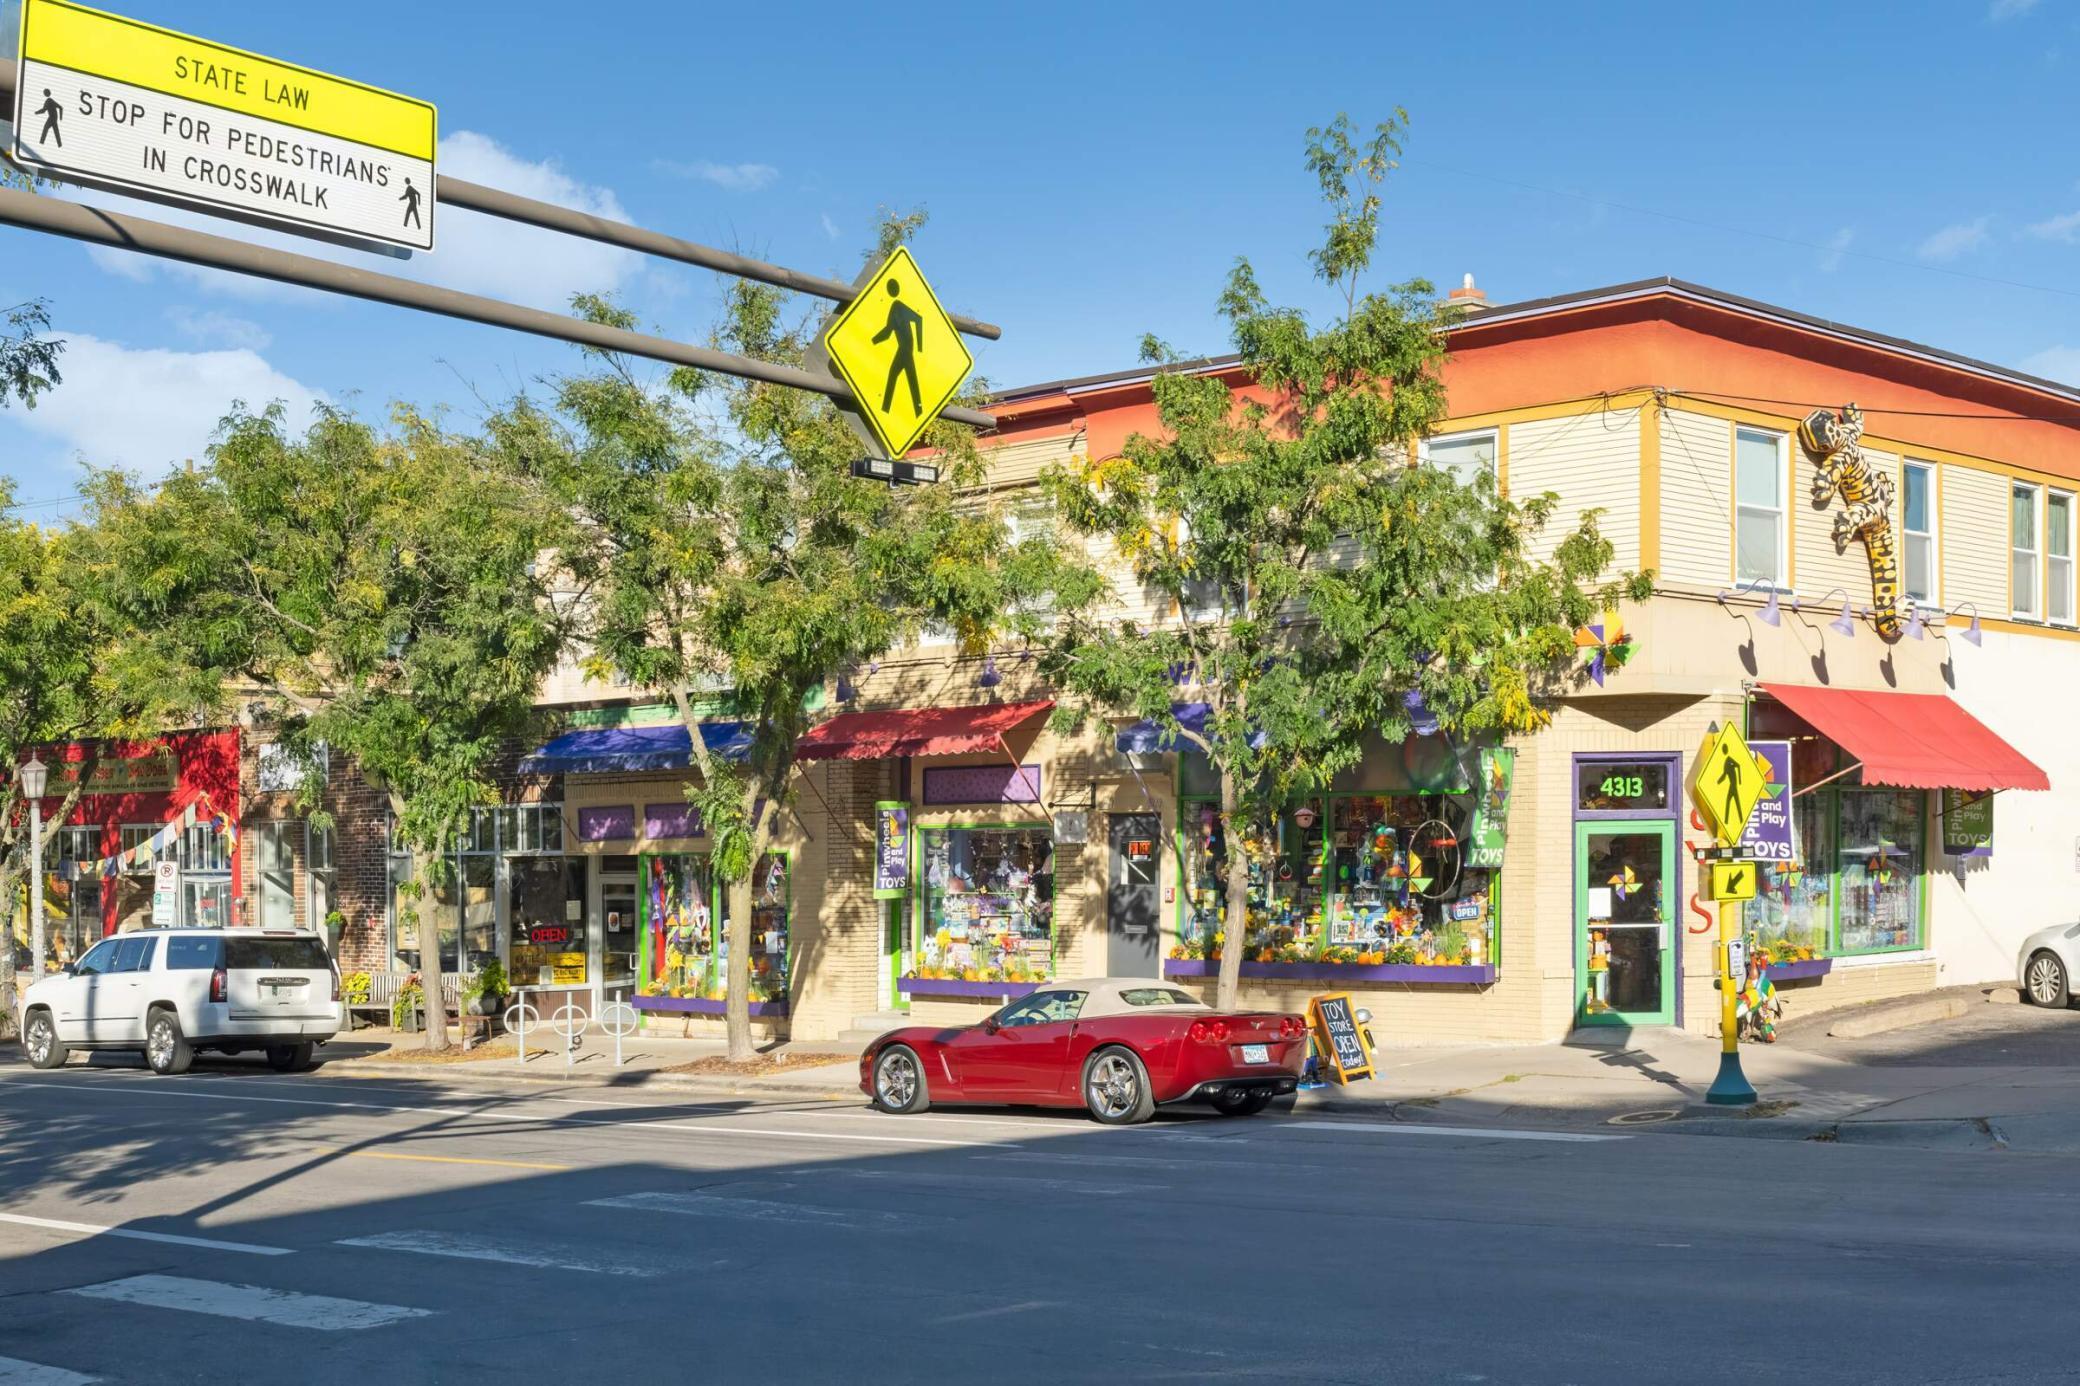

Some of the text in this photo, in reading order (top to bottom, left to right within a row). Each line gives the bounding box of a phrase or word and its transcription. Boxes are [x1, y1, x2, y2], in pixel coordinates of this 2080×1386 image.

[174, 55, 310, 111] STATE LAW
[78, 89, 391, 187] STOP FOR PEDESTRIANS
[143, 145, 329, 211] IN CROSSWALK
[1600, 776, 1643, 797] 4313
[1761, 800, 1782, 812] and
[1761, 812, 1787, 829] Play
[1963, 811, 1986, 823] Play
[880, 810, 890, 877] Pinwheels
[1948, 832, 1988, 846] TOYS
[891, 848, 904, 857] and
[1471, 848, 1505, 866] TOYS
[891, 857, 905, 868] Play
[880, 876, 906, 888] TOYS
[1456, 907, 1477, 918] OPEN
[531, 927, 567, 943] OPEN
[1320, 1000, 1346, 1020] TOY
[1329, 1020, 1354, 1033] STORE
[1333, 1033, 1361, 1054] OPEN
